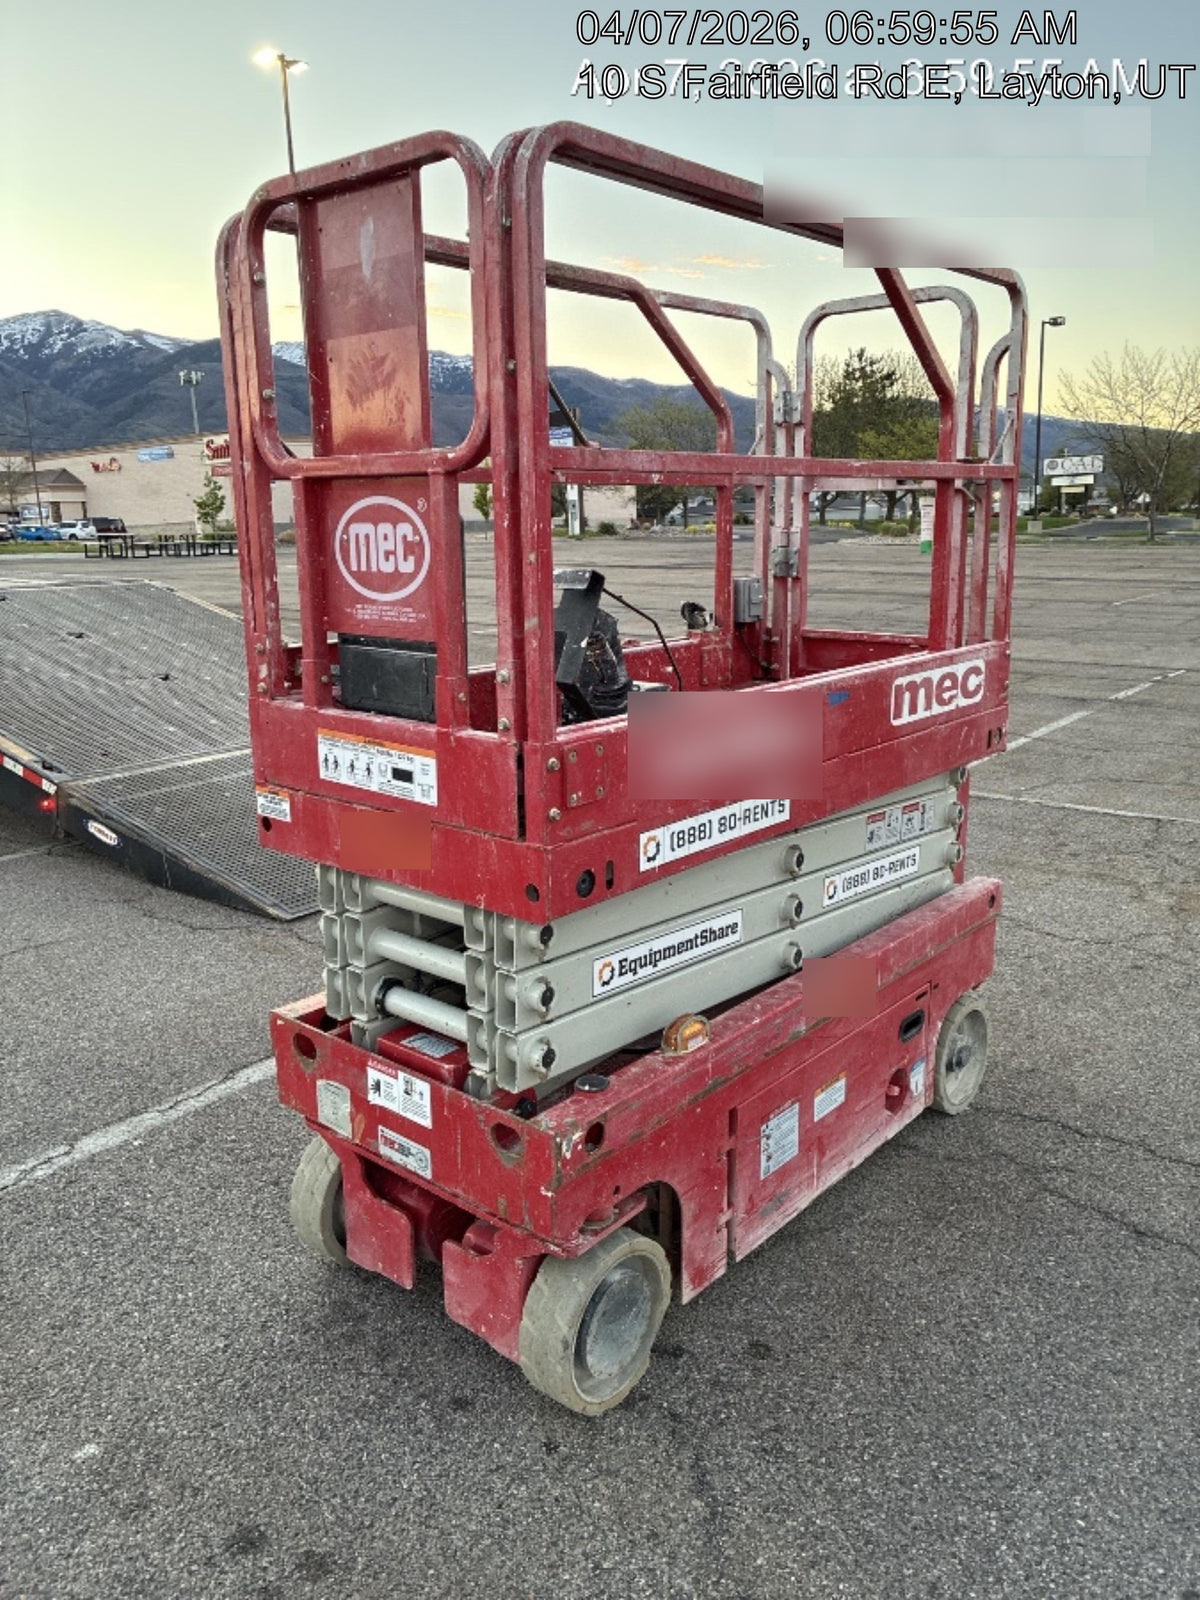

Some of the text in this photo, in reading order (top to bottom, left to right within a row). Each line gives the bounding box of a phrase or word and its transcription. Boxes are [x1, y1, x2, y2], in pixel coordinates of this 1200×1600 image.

[670, 799, 786, 851] (888) 80-RENTS
[842, 853, 917, 893] (888) 80-RENTS
[618, 921, 739, 977] EquipmentShare
